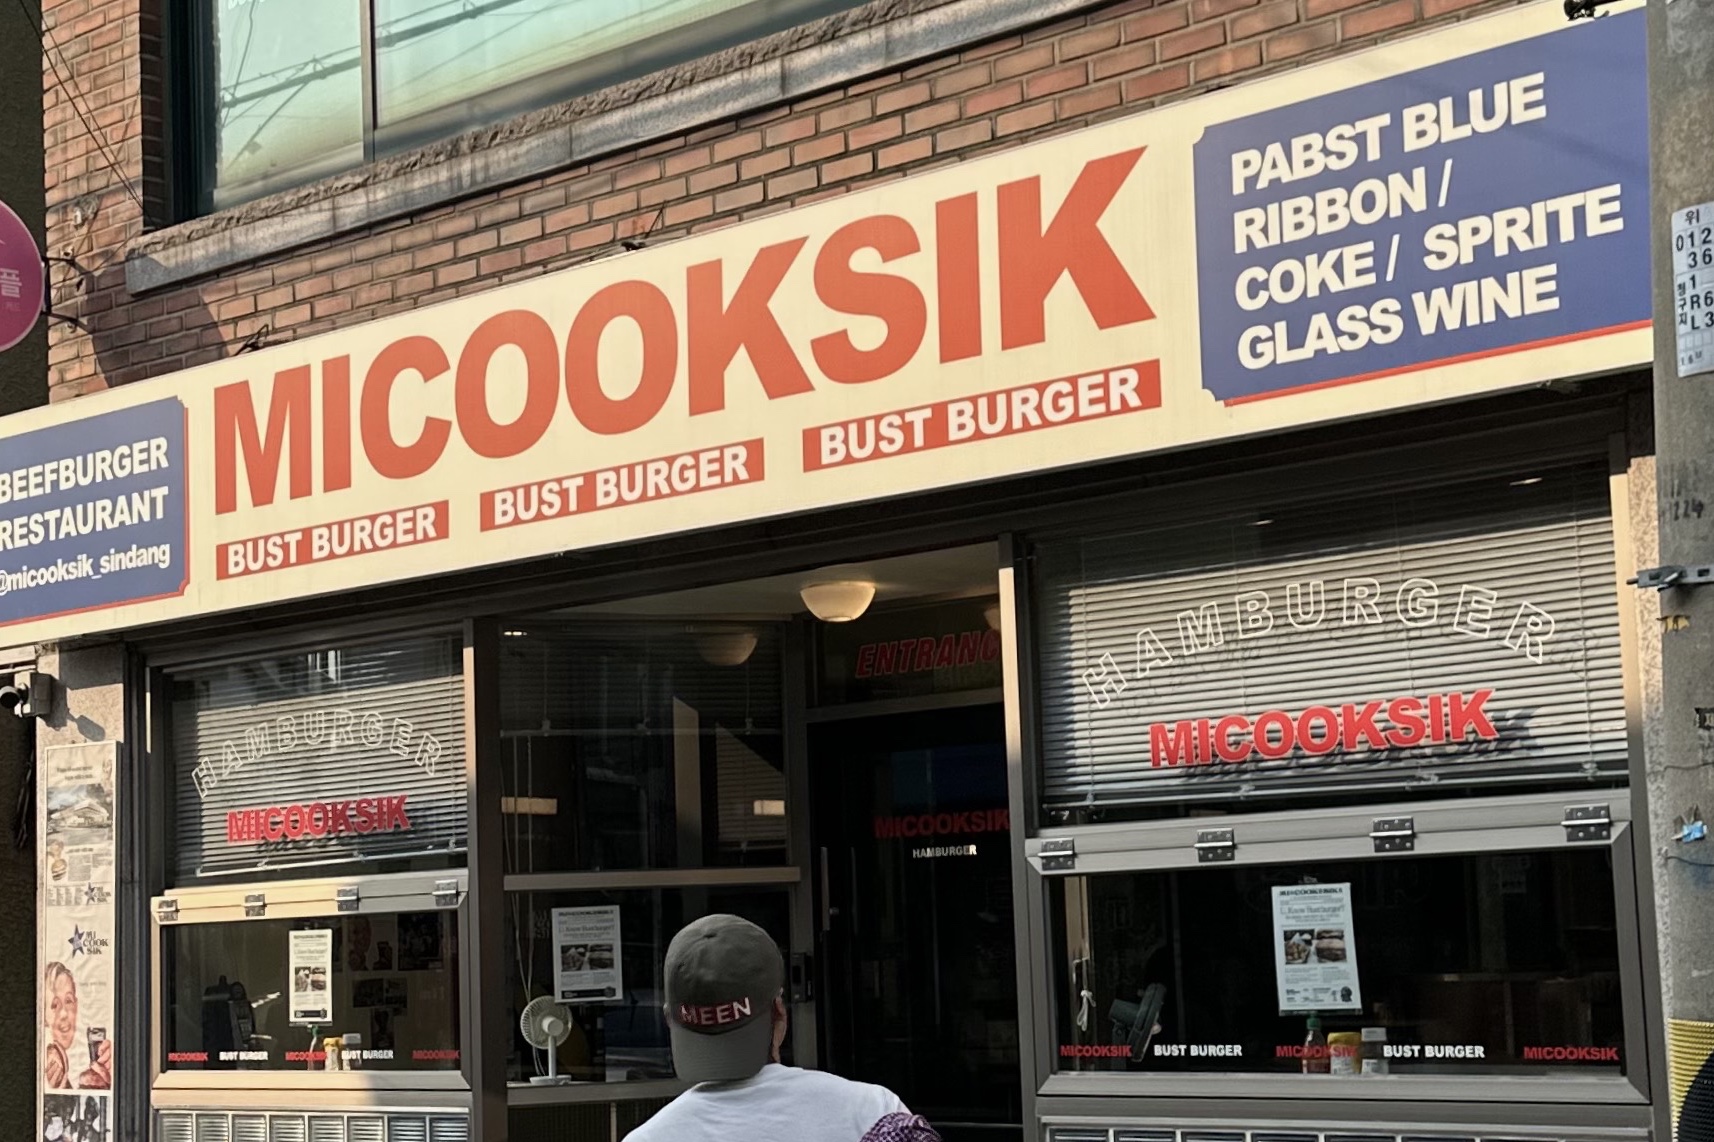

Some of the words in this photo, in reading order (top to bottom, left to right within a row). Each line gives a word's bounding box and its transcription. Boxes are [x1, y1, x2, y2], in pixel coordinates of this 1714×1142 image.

[1231, 113, 1391, 195] PABST
[1402, 72, 1547, 152] BLUE
[1233, 166, 1427, 253] RIBBON
[1235, 241, 1377, 311] COKE
[1423, 184, 1624, 271] SPRITE
[213, 146, 1157, 515] MICOOKSIK
[1237, 298, 1405, 369] GLASS
[1412, 263, 1560, 336] WINE
[819, 407, 933, 465] BUST
[947, 367, 1143, 441] BURGER
[0, 437, 169, 504] BEEFBURGER
[493, 476, 585, 526] BUST
[595, 444, 750, 508] BURGER
[0, 486, 169, 550] RESTAURANT
[227, 532, 303, 575] BUST
[312, 506, 437, 559] BURGER
[0, 543, 170, 596] @micooksik_sindang
[1082, 577, 1556, 709] HAMBURGER
[191, 708, 442, 798] HAMBURGER
[1149, 688, 1496, 769] MICOOKSIK
[227, 795, 410, 844] MICOOKSIK
[912, 844, 977, 858] HAMBURGER
[1060, 1045, 1132, 1057] MICOOKSIK
[1153, 1044, 1187, 1056] BUST
[1190, 1044, 1243, 1056] BURGER
[1383, 1045, 1420, 1057] BUST
[1424, 1045, 1485, 1058] BURGER
[1523, 1047, 1619, 1061] MICOOKSIK
